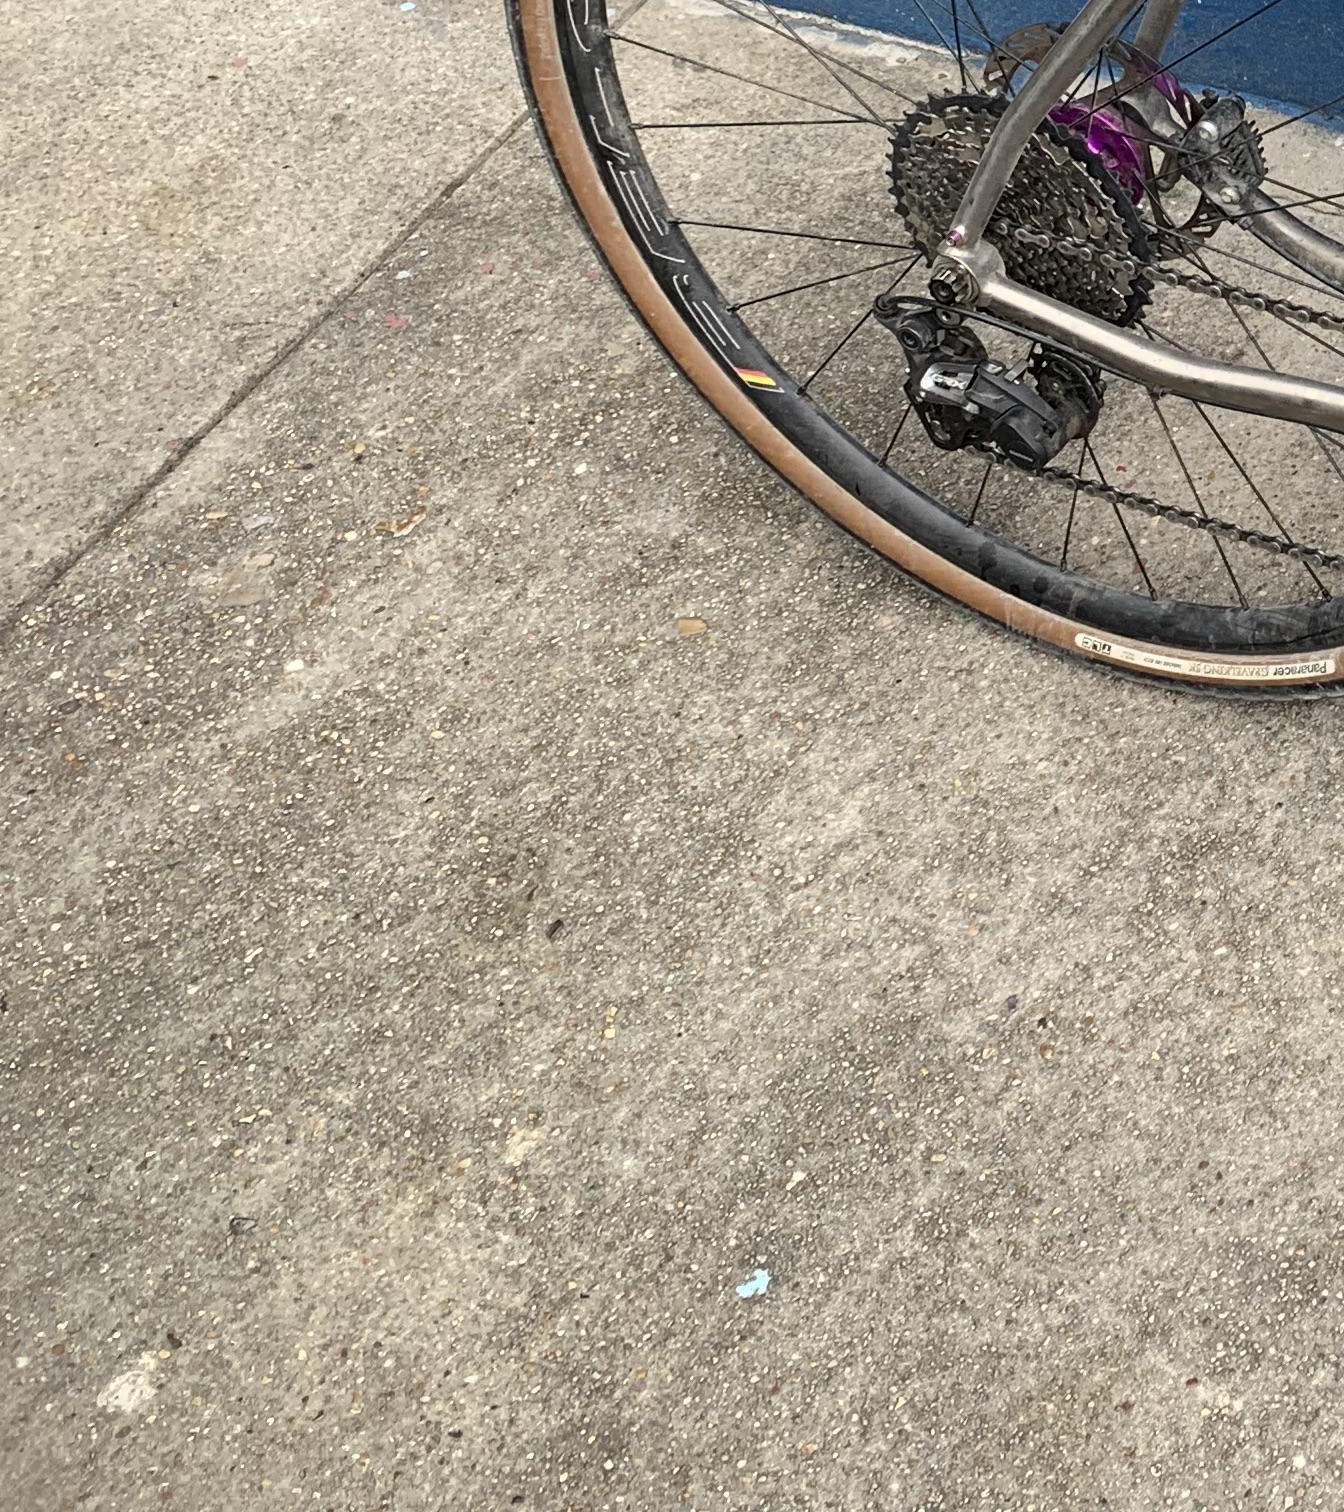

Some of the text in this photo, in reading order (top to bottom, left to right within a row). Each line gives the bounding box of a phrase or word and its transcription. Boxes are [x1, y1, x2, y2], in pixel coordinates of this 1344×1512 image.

[1081, 636, 1112, 655] TLC
[1203, 664, 1270, 679] GRAVELKING
[1273, 660, 1327, 676] Panaracer
